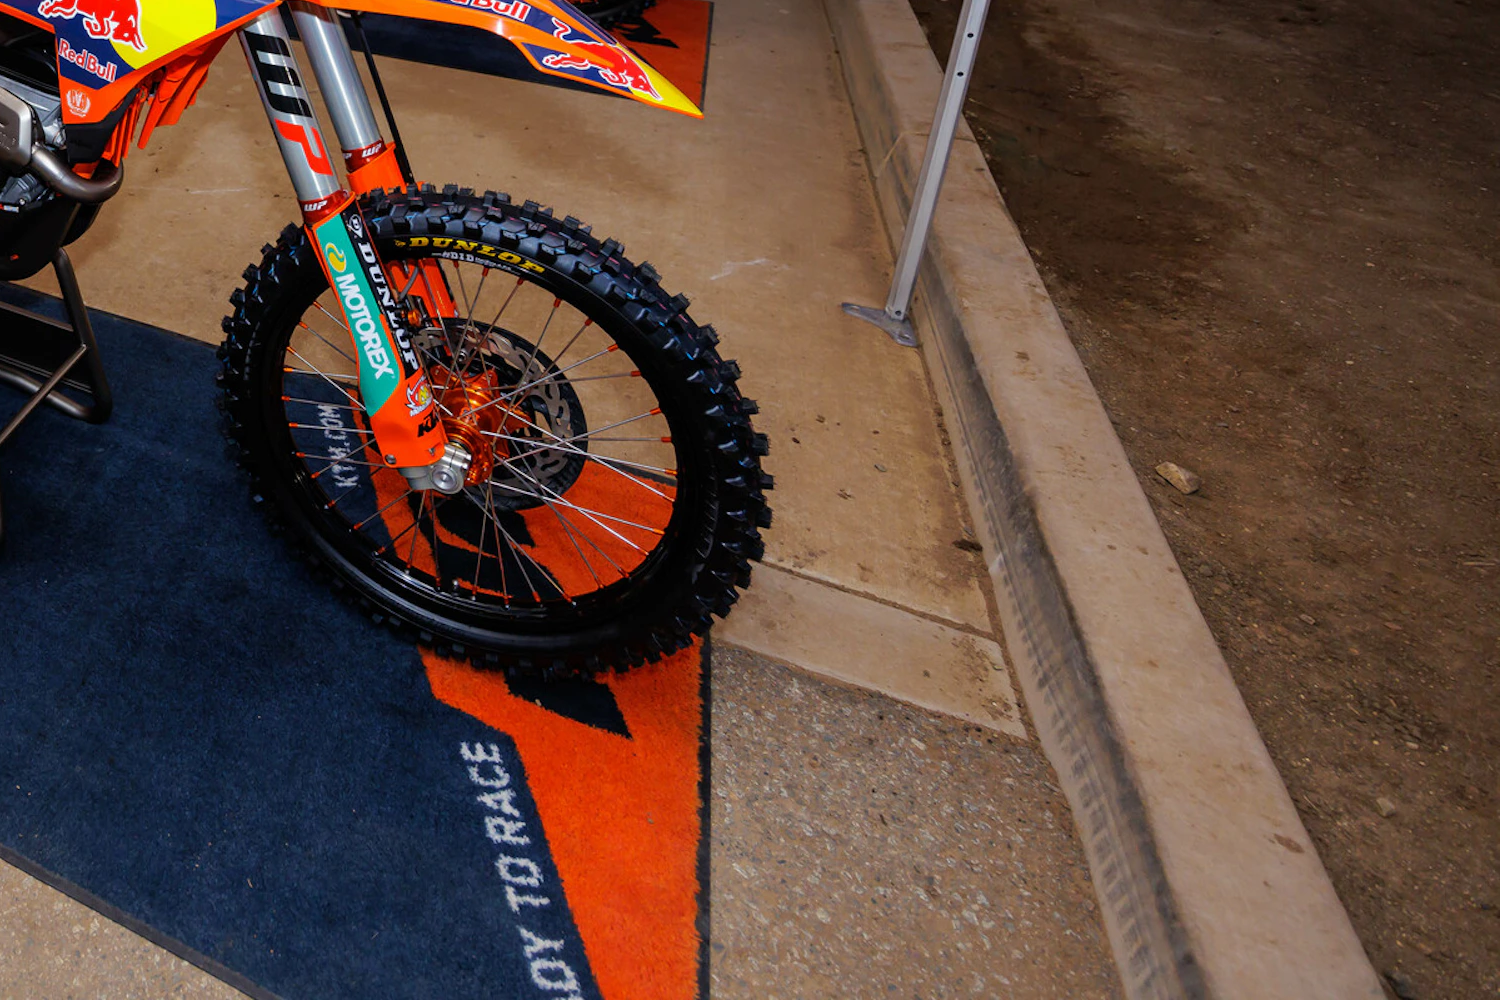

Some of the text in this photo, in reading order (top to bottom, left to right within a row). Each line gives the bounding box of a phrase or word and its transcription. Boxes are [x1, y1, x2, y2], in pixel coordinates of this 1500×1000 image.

[59, 39, 117, 83] Red Bull
[303, 200, 328, 212] WP
[408, 236, 546, 274] DUNLOP
[334, 273, 393, 381] MOTOREX
[359, 240, 420, 372] DUNLOP
[458, 739, 532, 846] RACE
[494, 852, 552, 915] TO
